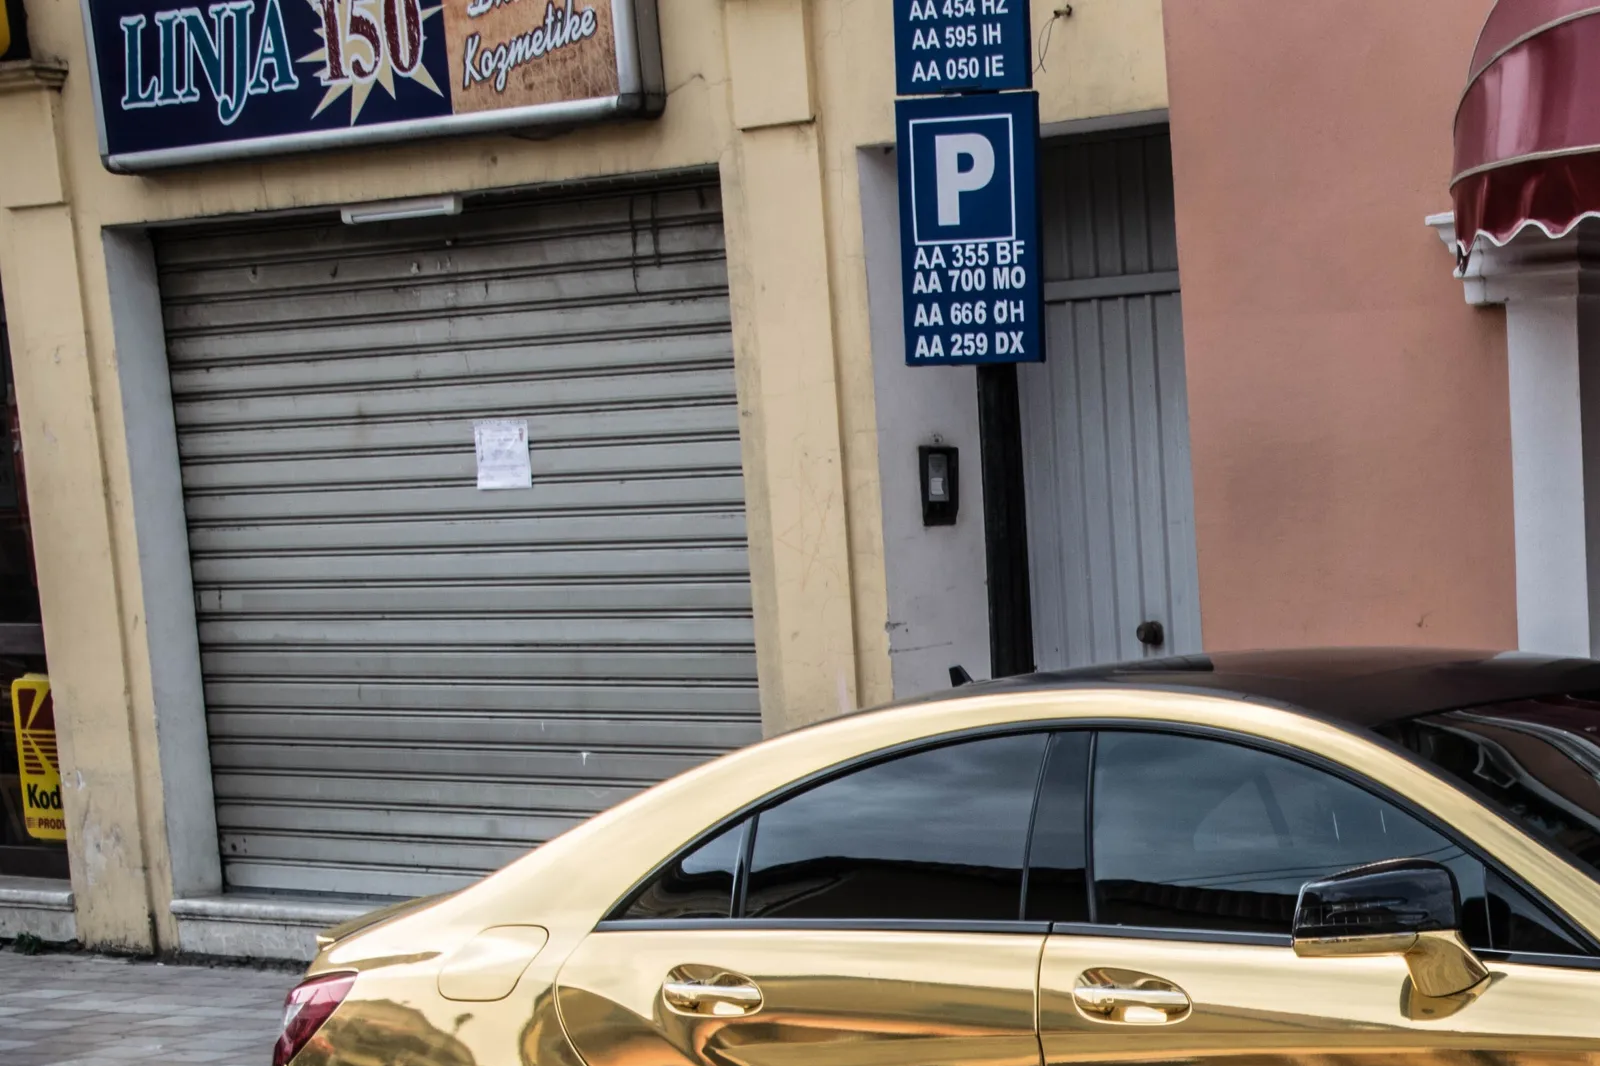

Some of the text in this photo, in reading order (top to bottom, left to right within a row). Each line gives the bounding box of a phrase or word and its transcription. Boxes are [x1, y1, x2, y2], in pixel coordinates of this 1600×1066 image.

[909, 0, 938, 21] AA
[942, 0, 976, 18] 454
[463, 0, 597, 93] Kozmetike
[912, 23, 1002, 50] AA 595 IH
[121, 0, 424, 125] LINJA 150
[912, 55, 1004, 82] AA 050 IE
[935, 133, 995, 226] P
[914, 241, 1025, 270] AA 355 BF
[913, 266, 1026, 294] AA 700 MO
[914, 302, 944, 327] AA
[950, 300, 987, 325] 666
[915, 331, 1024, 358] AA 259 DX
